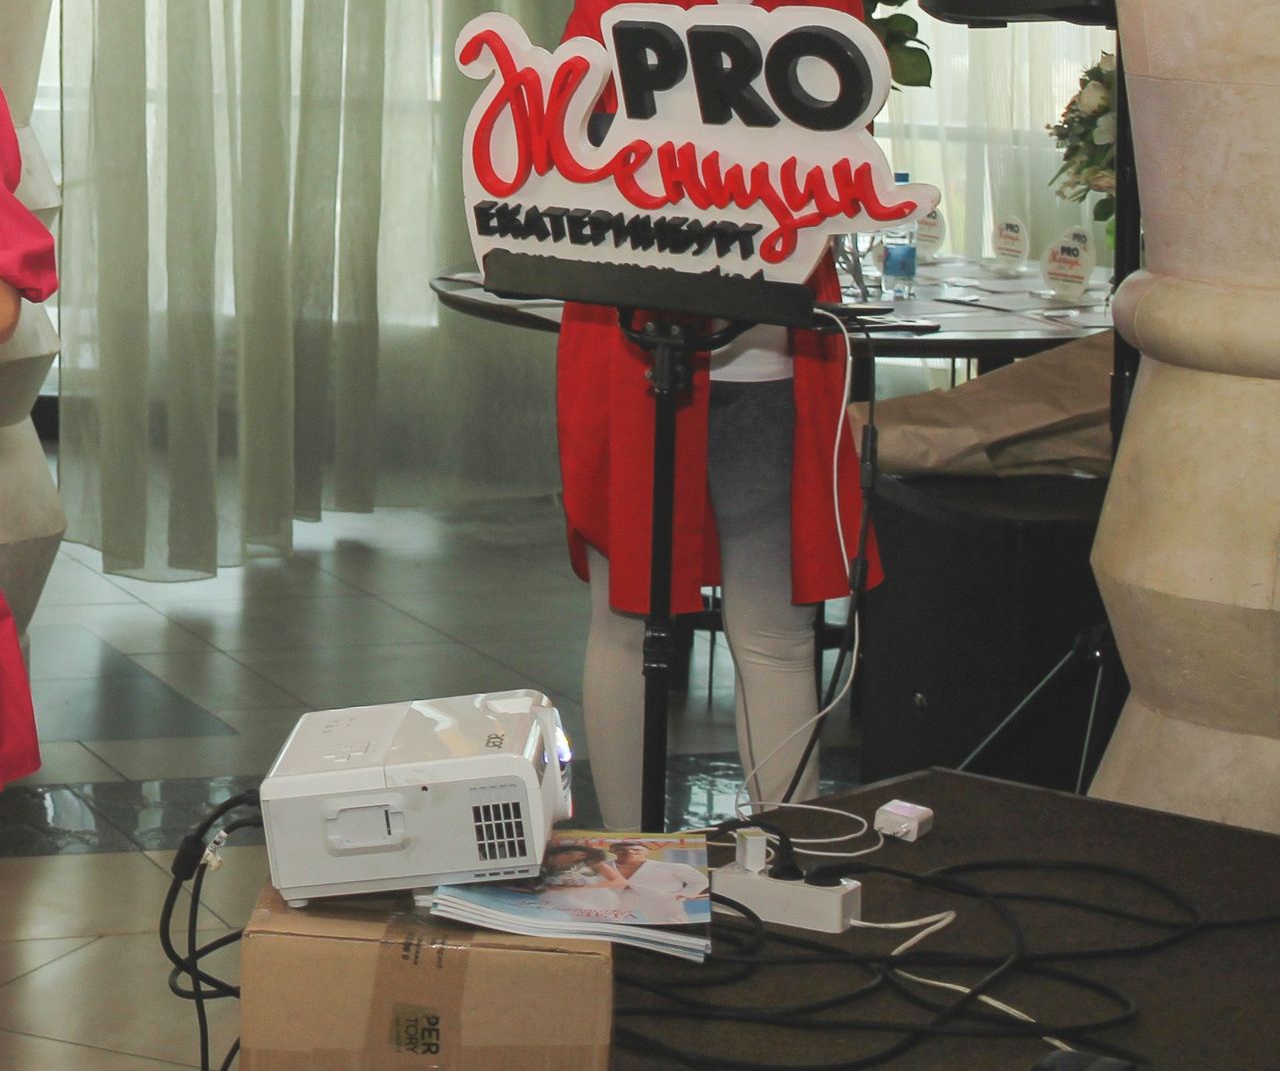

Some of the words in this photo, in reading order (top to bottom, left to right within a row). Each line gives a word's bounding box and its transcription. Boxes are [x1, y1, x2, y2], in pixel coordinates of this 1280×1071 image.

[612, 20, 873, 132] PRO
[459, 29, 918, 264] Женщин
[473, 200, 764, 260] ЕКАТЕРИНБУРГ
[1005, 223, 1020, 234] PRO
[1060, 246, 1080, 257] PRO
[485, 733, 505, 749] acer
